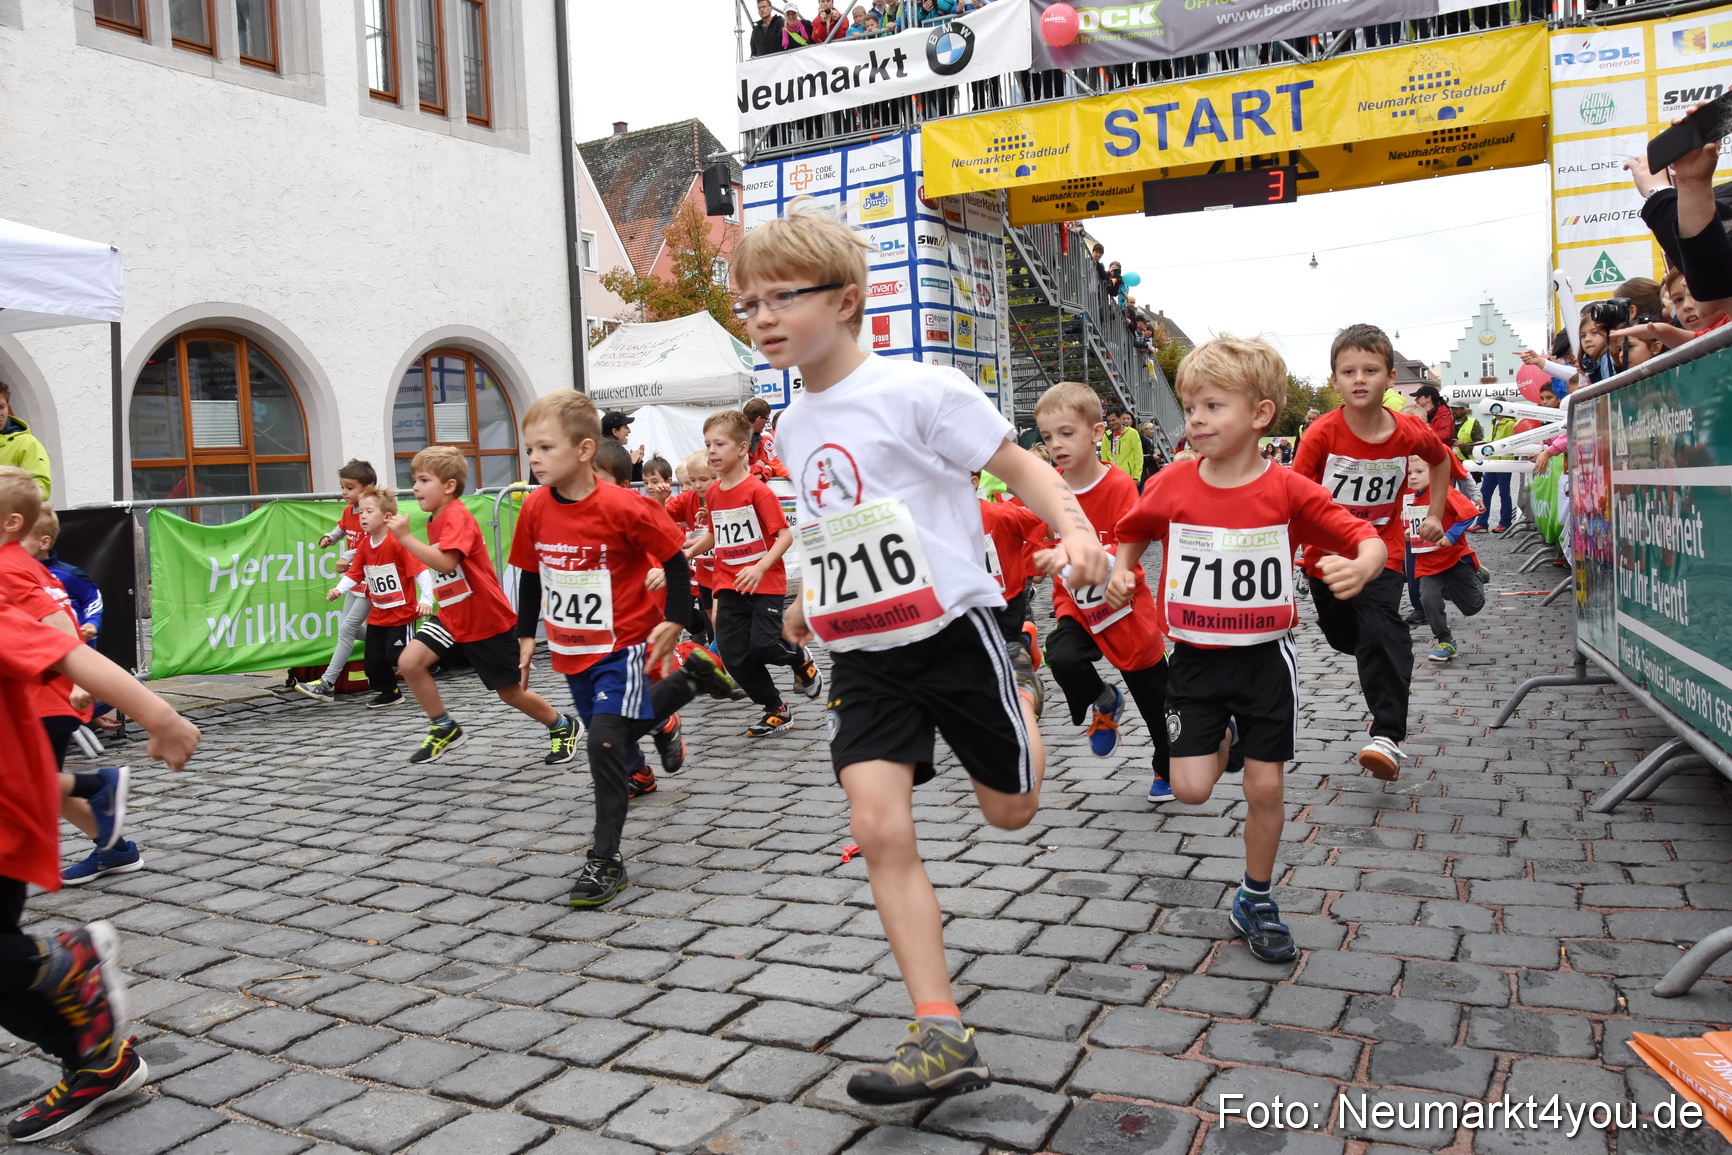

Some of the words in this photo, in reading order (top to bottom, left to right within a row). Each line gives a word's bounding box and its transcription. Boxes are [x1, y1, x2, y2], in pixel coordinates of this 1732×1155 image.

[1078, 4, 1157, 30] OCK
[928, 22, 971, 46] BMW
[1599, 57, 1640, 70] energie
[737, 48, 908, 114] Neumarkt
[1357, 91, 1438, 112] Neumarkter
[1441, 80, 1507, 100] Stadtlauf
[1104, 80, 1314, 157] START
[951, 150, 1017, 168] Neumarkter
[1018, 143, 1071, 161] Stadtlauf
[1388, 144, 1458, 160] Neumarkter
[1460, 133, 1516, 152] Stadtlauf
[815, 165, 833, 174] CODE
[815, 171, 836, 181] CLINIC
[849, 161, 887, 174] RAIL.ONE
[1558, 161, 1618, 174] RAIL.ONE
[1031, 190, 1088, 204] Neumarkter
[1089, 184, 1136, 198] Stadtlauf
[1268, 170, 1285, 201] 3
[1452, 389, 1482, 399] BMW
[1485, 387, 1522, 399] Laufsp
[1629, 407, 1693, 443] Event-Leit-Systeme
[1332, 472, 1397, 503] 7181
[715, 519, 755, 544] 7121
[827, 503, 896, 535] BOCK
[1618, 499, 1643, 542] Mehr
[1645, 500, 1705, 559] Sicherheit
[723, 546, 752, 558] Raphael
[1222, 531, 1279, 547] BOCK
[556, 574, 602, 585] BOCK
[810, 533, 916, 607] 7216
[1181, 555, 1282, 601] 7180
[1619, 555, 1633, 599] für
[1635, 560, 1649, 606] Ihr
[1651, 568, 1689, 626] Event!
[545, 585, 602, 625] 7242
[828, 603, 921, 635] Konstantin
[1182, 609, 1276, 630] Maximilian
[1635, 646, 1642, 672] &
[1642, 650, 1664, 689] Service
[1665, 665, 1684, 703] Line:
[1685, 678, 1714, 723] 09181
